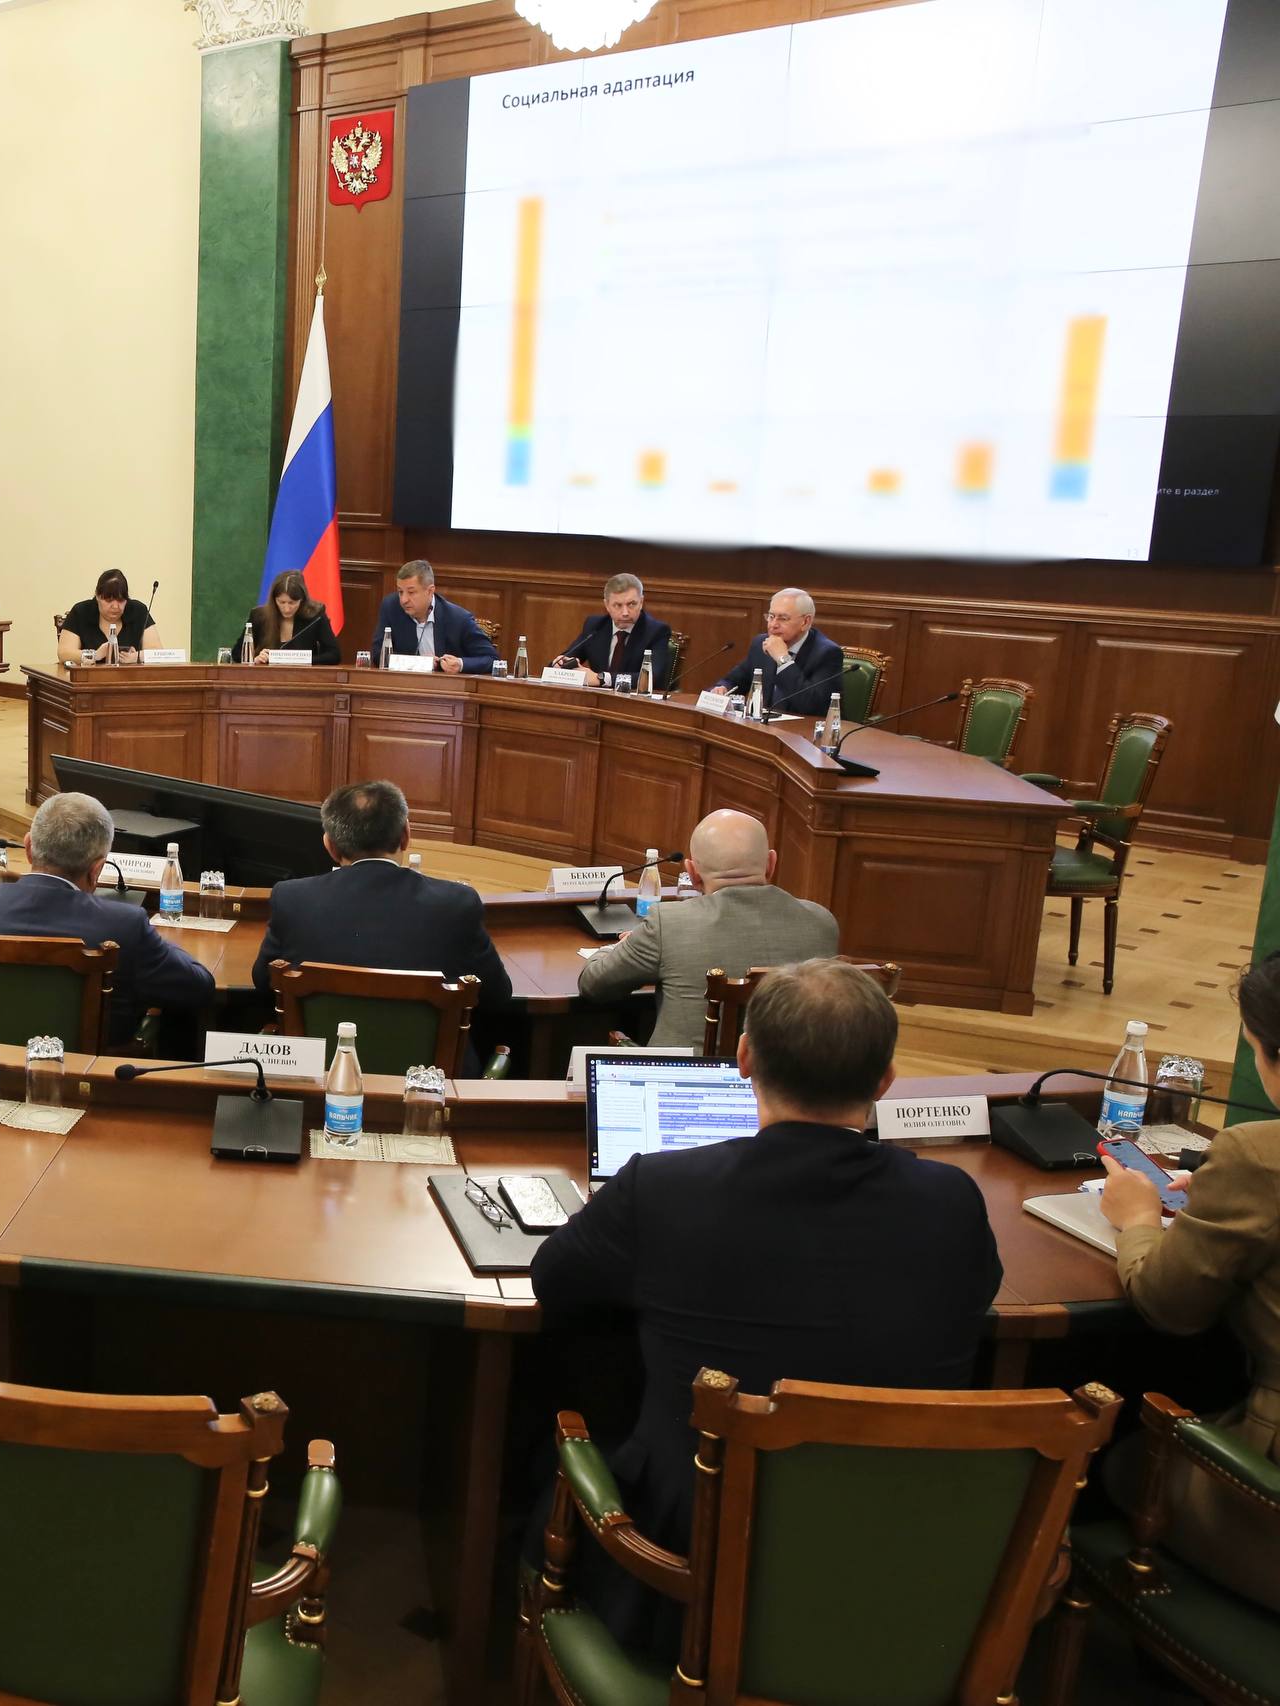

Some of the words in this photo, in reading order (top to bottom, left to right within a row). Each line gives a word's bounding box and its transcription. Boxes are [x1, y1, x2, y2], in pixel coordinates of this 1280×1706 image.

[502, 84, 598, 109] Социальная
[603, 69, 695, 96] адаптация
[570, 871, 606, 880] БЕКОЕВ
[239, 1041, 292, 1056] ДАДОВ
[896, 1105, 971, 1119] ПОРТЕНКО
[904, 1120, 926, 1128] ЮЛИЯ
[927, 1120, 966, 1128] ОЛЕГОВНА
